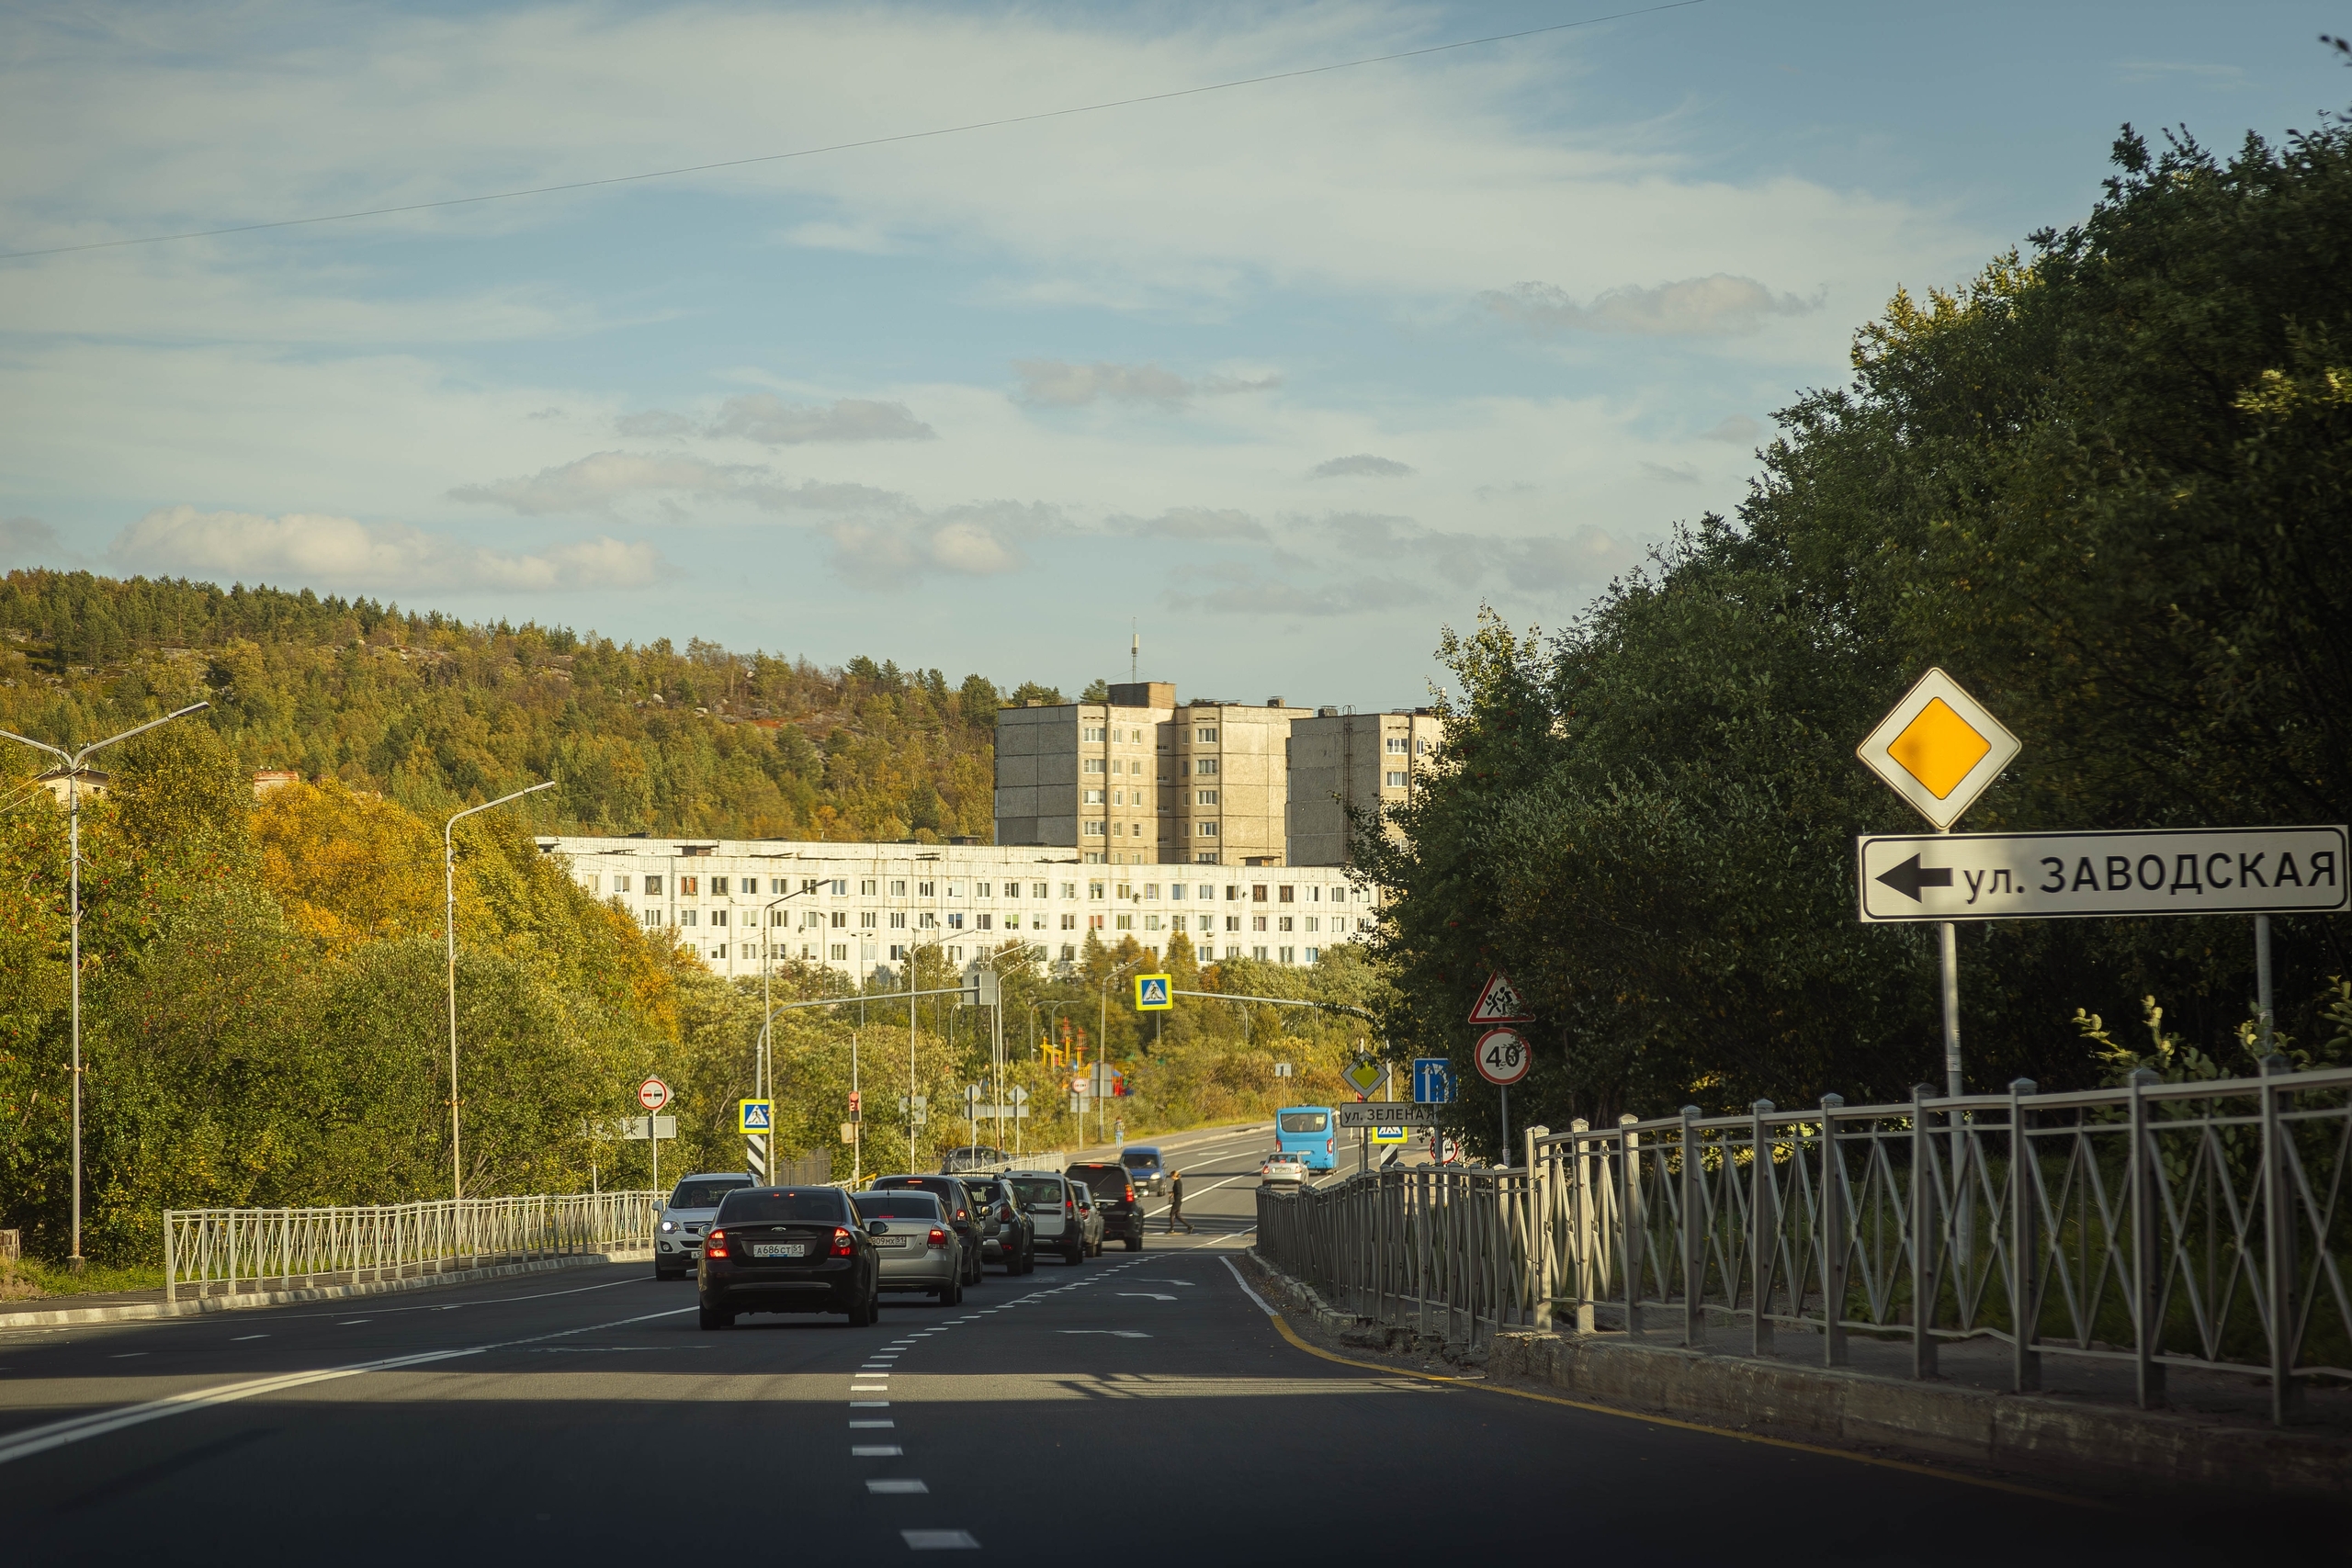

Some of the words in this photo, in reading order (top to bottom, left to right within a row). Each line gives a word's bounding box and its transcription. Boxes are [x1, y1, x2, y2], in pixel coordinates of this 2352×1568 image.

[1962, 868, 2026, 905] ул.
[2039, 851, 2337, 896] ЗАВОДСКАЯ
[1485, 1044, 1521, 1068] 40
[1344, 1111, 1364, 1123] ул.
[1366, 1108, 1435, 1121] ЗЕЛЕНАЯ
